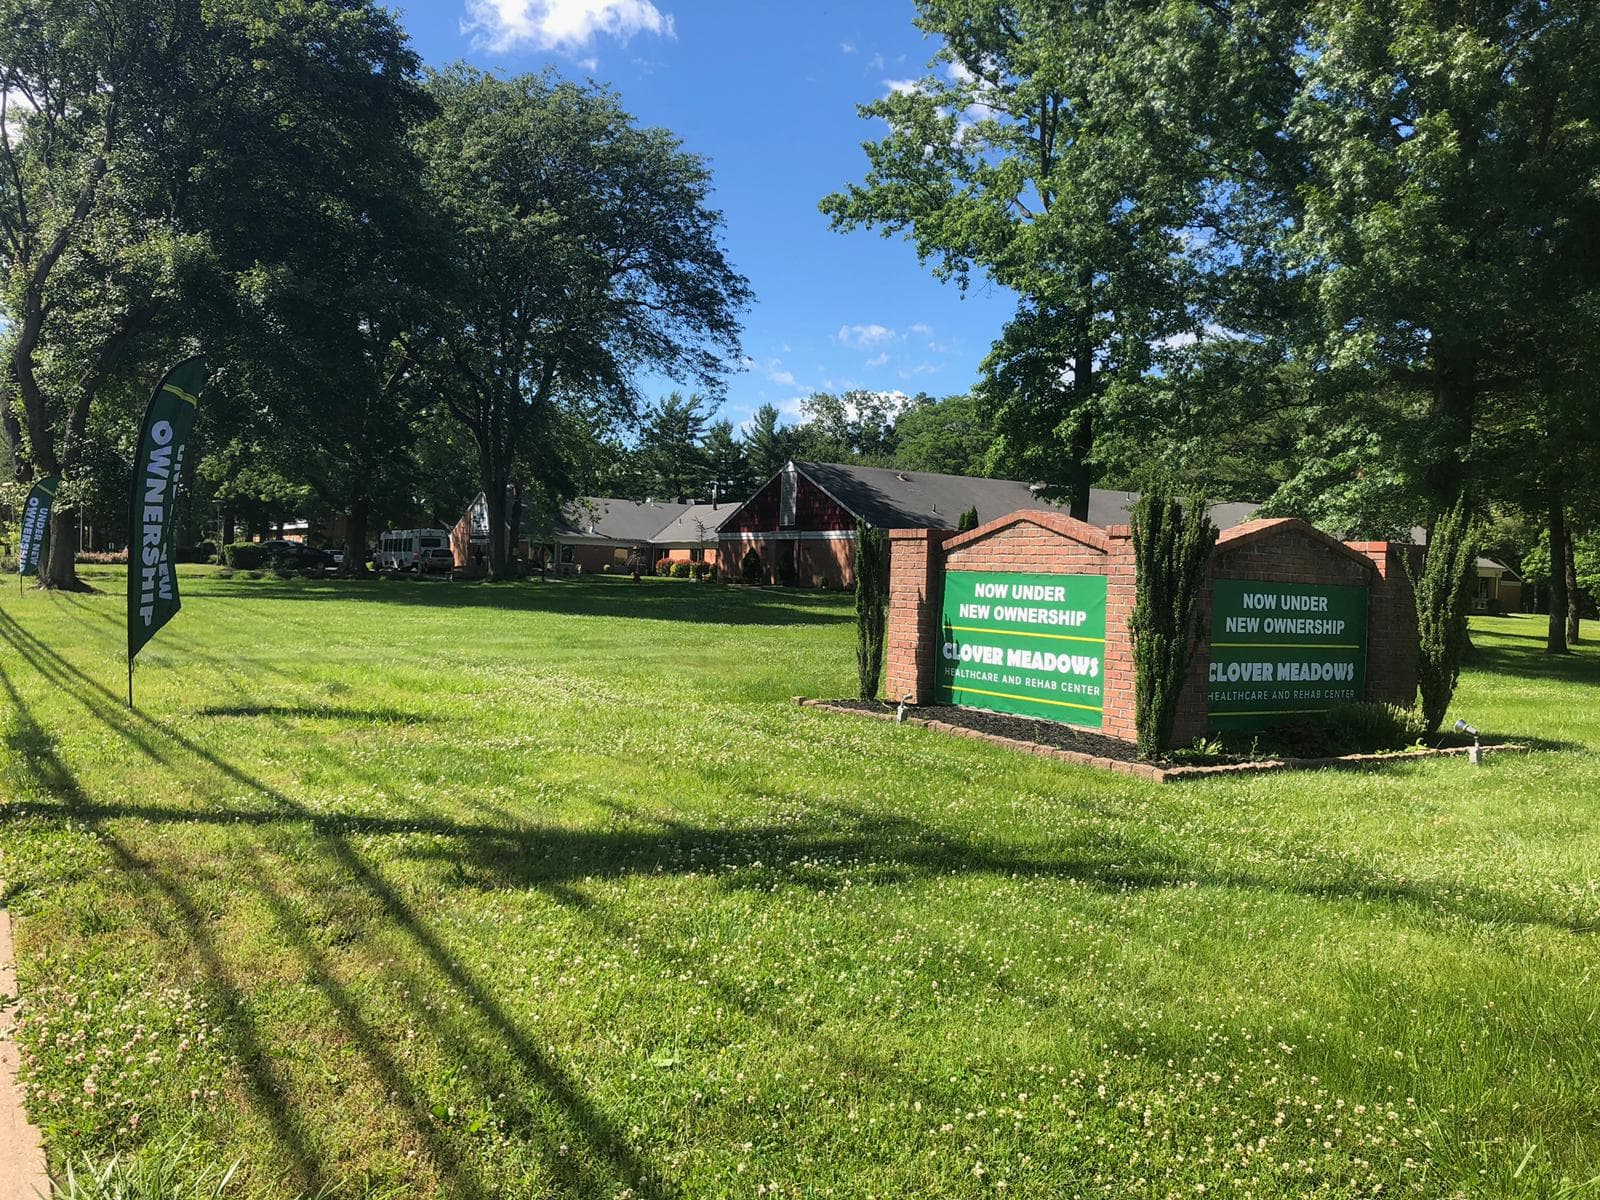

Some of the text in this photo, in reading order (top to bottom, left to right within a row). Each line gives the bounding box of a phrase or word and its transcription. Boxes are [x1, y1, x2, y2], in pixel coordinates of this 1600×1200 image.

[20, 497, 39, 573] OWNERSHIP
[140, 420, 173, 627] OWNERSHIP
[30, 507, 48, 566] UNDER NEW
[975, 583, 1065, 602] NOW UNDER
[1243, 593, 1328, 612] NOW UNDER
[959, 603, 1087, 627] NEW OWNERSHIP
[1226, 617, 1345, 635] NEW OWNERSHIP
[942, 642, 1099, 678] CLOVER MEADOWS
[1208, 662, 1354, 682] CLOVER MEADOWS
[944, 667, 1100, 697] HEALTHCARE AND REHAB CENTER
[1207, 689, 1355, 701] HEALTHCARE AND REHAB CENTER
